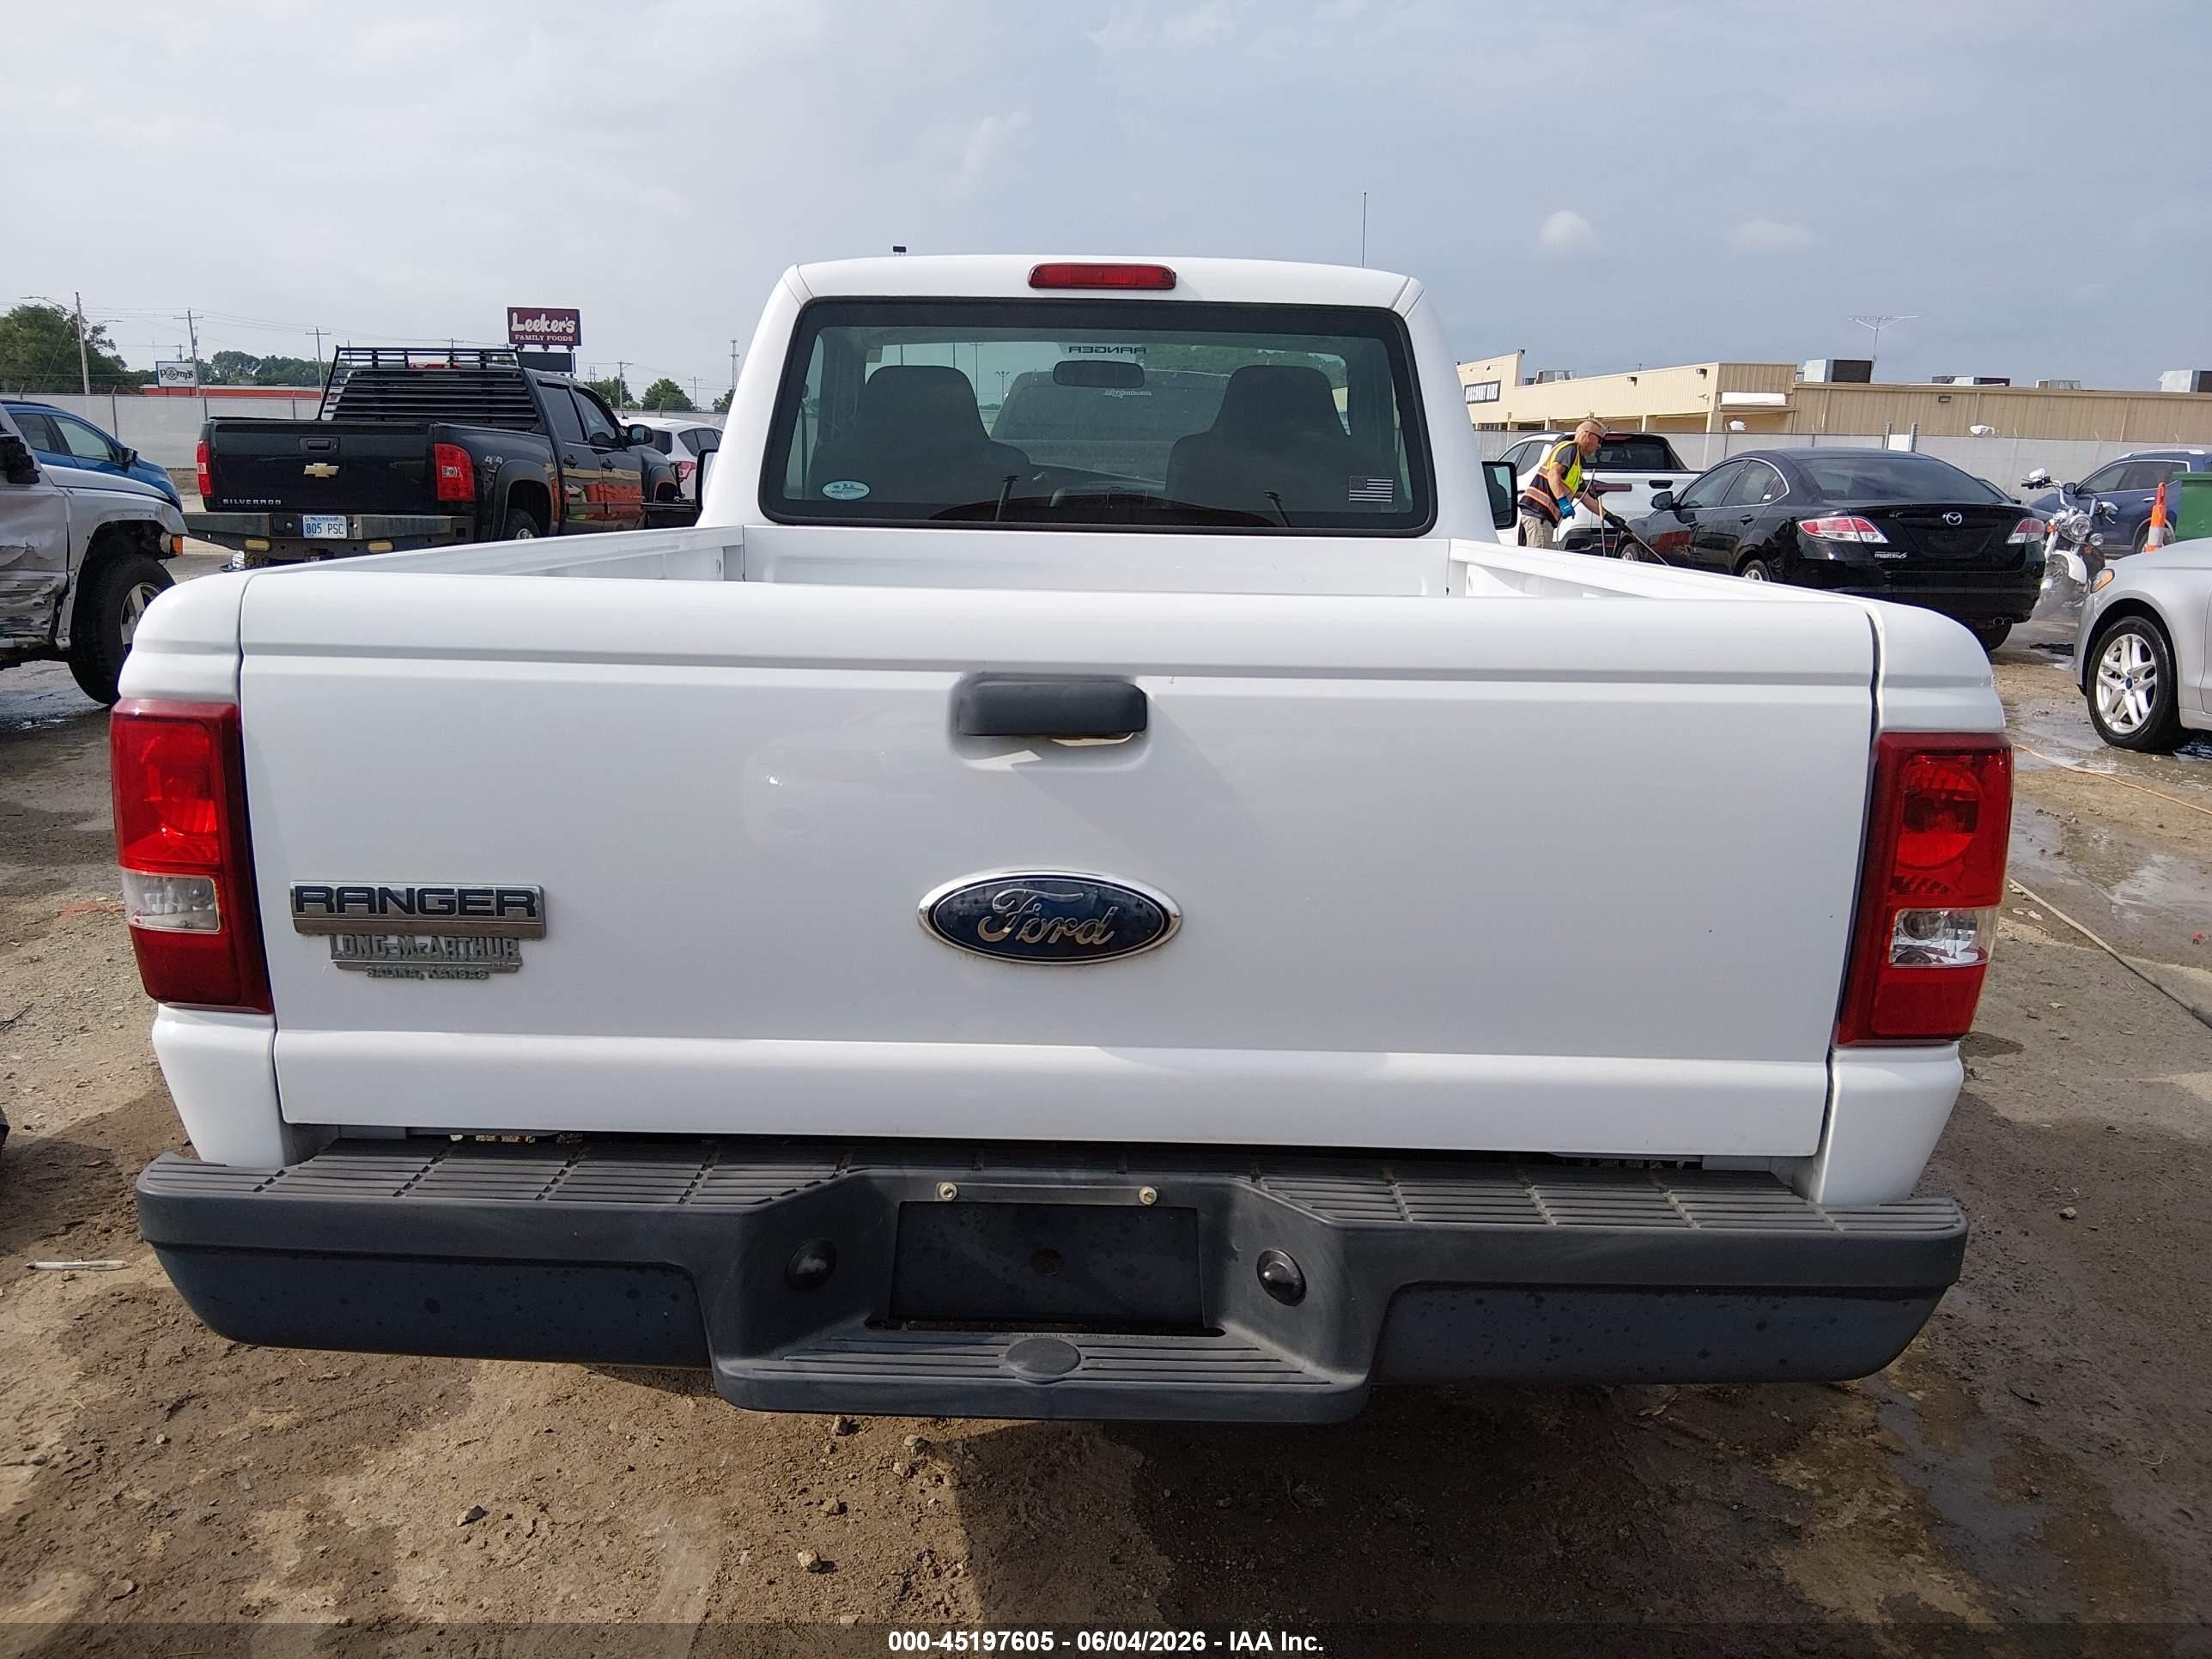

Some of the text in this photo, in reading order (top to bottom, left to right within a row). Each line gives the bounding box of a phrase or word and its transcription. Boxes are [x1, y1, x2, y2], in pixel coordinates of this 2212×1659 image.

[511, 312, 576, 334] Leeker's
[306, 522, 344, 535] 805 PSC
[295, 885, 537, 917] RANGER
[977, 888, 1119, 945] Ford
[429, 967, 490, 980] KANSAS
